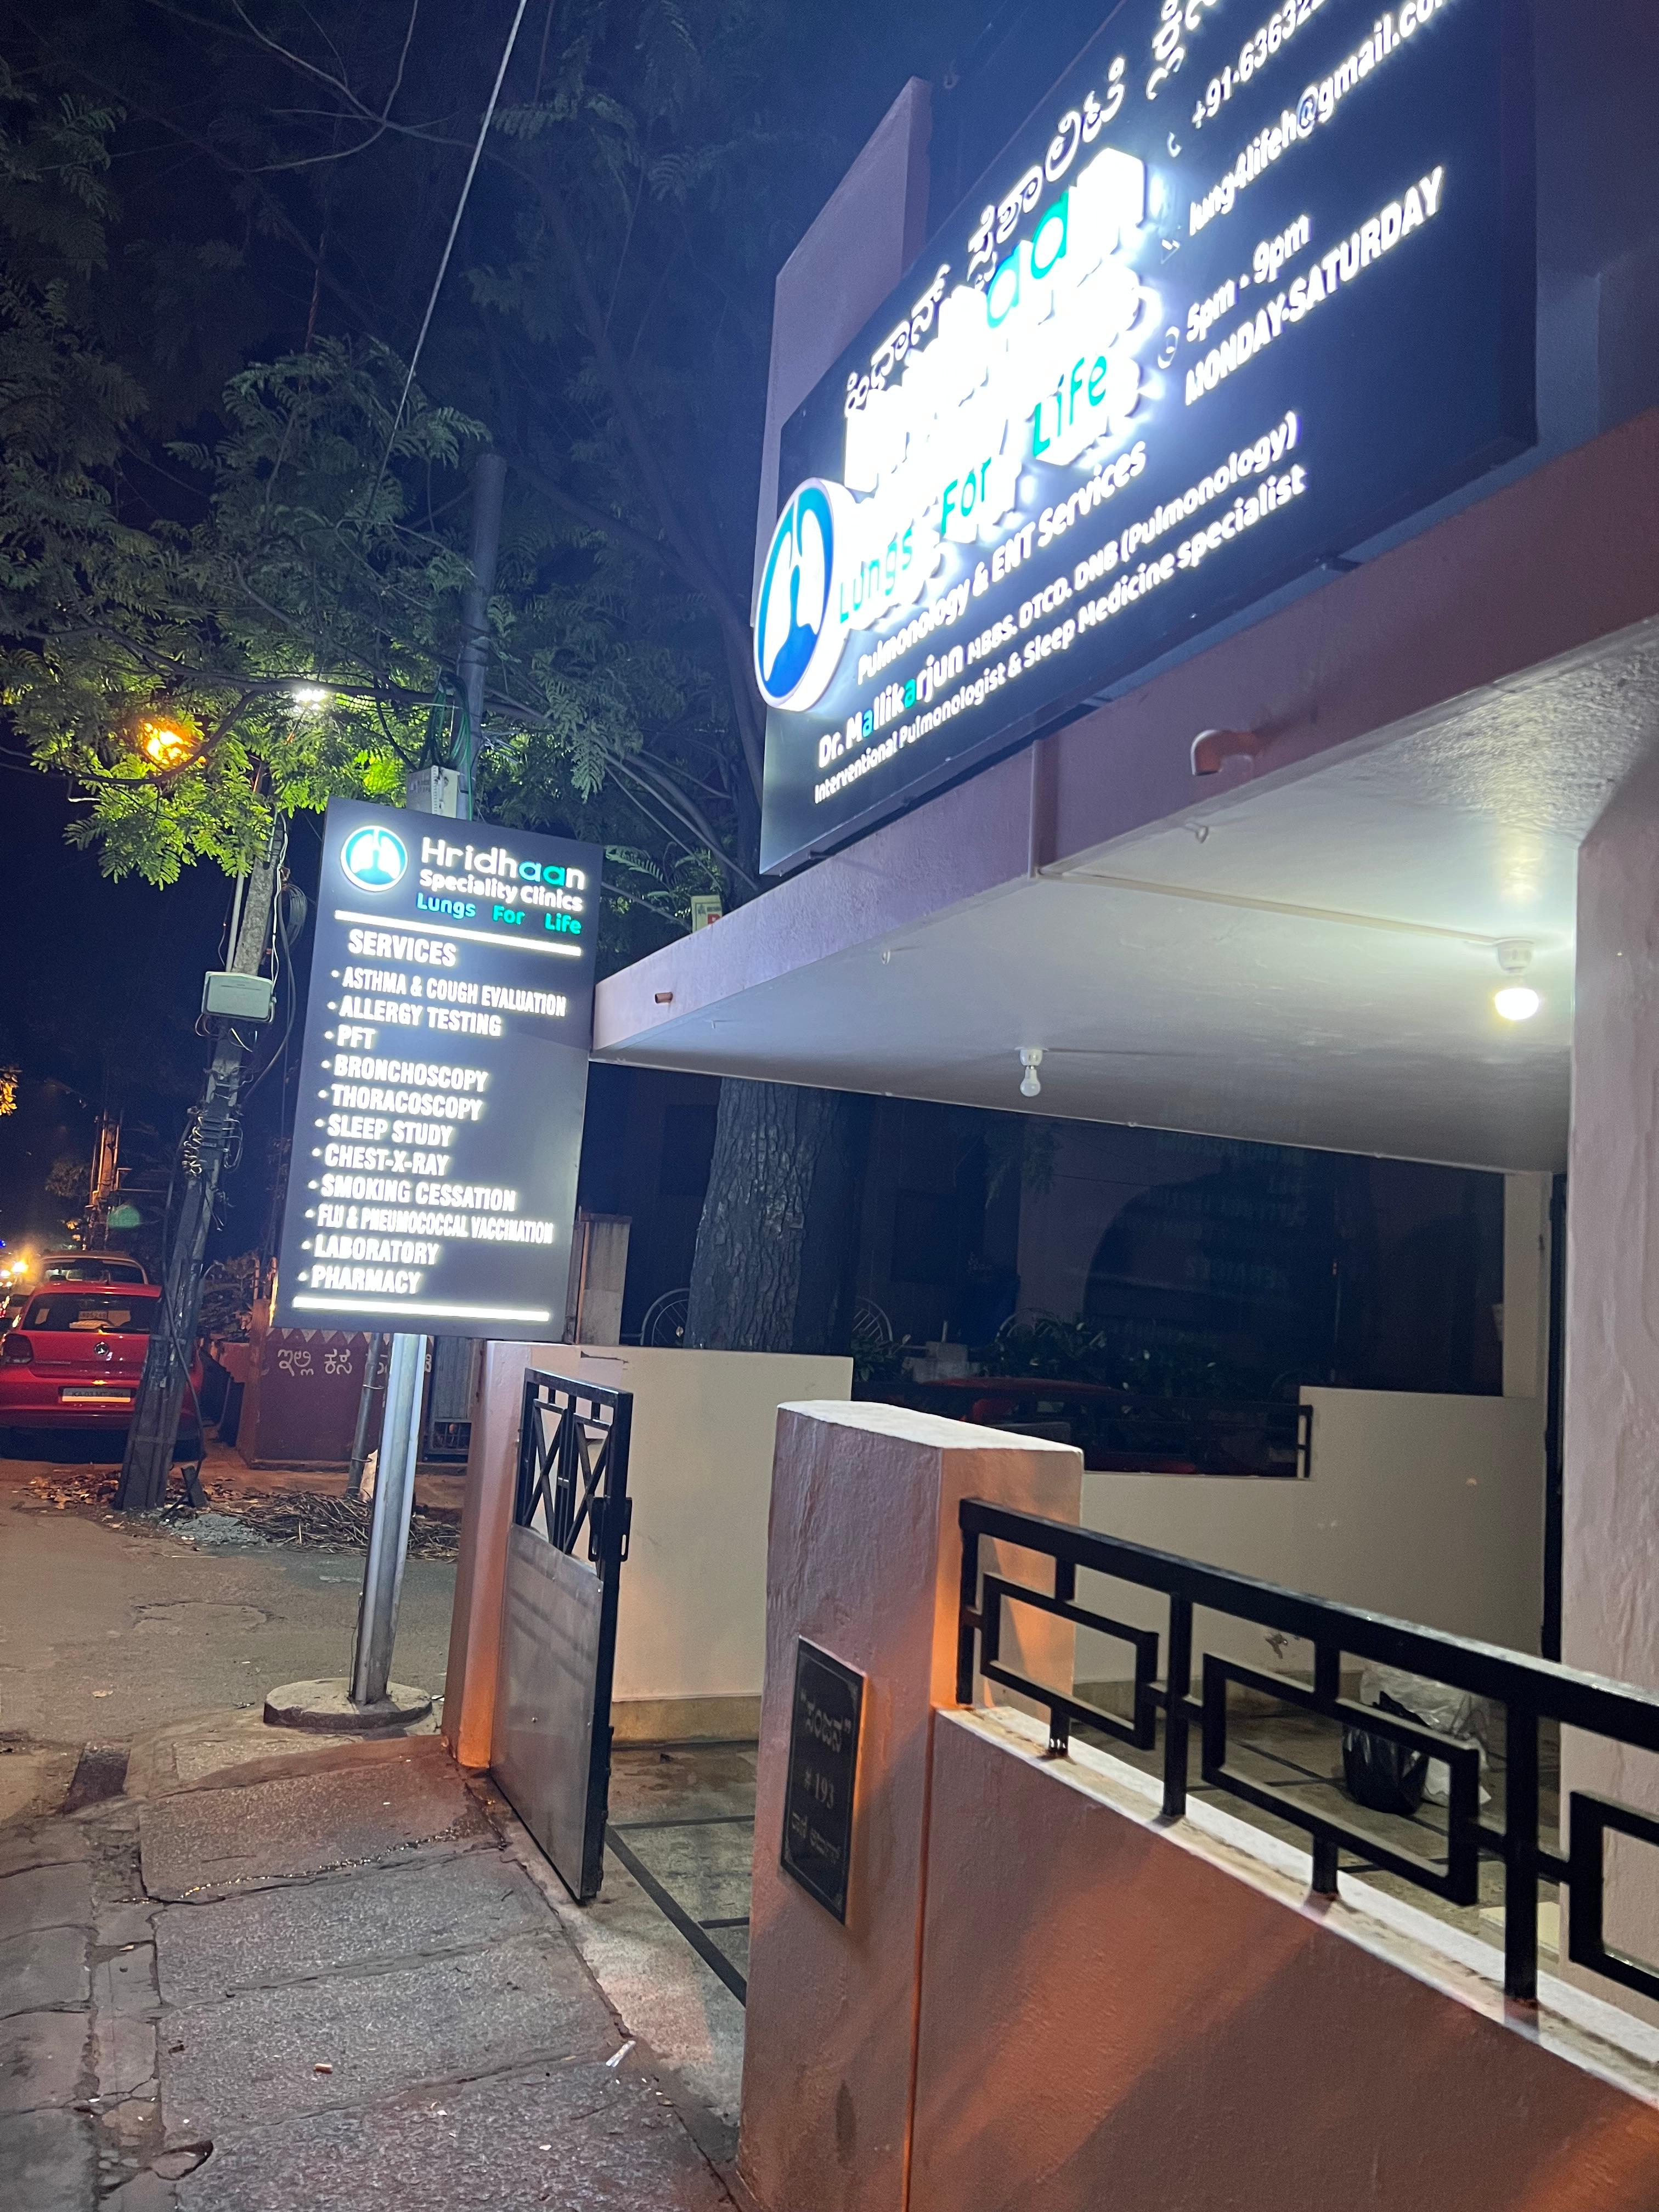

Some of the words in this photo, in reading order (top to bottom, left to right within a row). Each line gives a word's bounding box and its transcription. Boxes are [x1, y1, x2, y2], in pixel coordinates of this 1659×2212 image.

[1186, 279, 1238, 342] 5pm
[1252, 215, 1310, 283] 9pm
[941, 456, 992, 537] For
[1033, 356, 1107, 458] Life
[857, 578, 970, 685] Pulmonology
[973, 561, 988, 597] &
[992, 522, 1036, 583] ENT
[1038, 441, 1146, 547] Services
[819, 731, 844, 768] Dr.
[846, 645, 964, 749] Mallikarjun
[1074, 540, 1118, 591] DNB
[1120, 410, 1299, 562] (Pulmonology)
[815, 731, 899, 804] Interventional
[898, 662, 1006, 749] Pulmonologist
[1007, 652, 1023, 678] &
[1023, 619, 1076, 668] Sleep
[1077, 553, 1175, 633] Medicine
[421, 837, 585, 890] Hridhaan
[420, 868, 518, 904] Speciality
[520, 887, 584, 912] Clinics
[417, 893, 476, 919] Lungs
[492, 905, 525, 926] For
[544, 913, 582, 935] Life
[347, 928, 457, 967] SERVICES
[342, 966, 407, 995] ASTHMA
[410, 975, 422, 997] &
[426, 977, 478, 1005] COUGH
[481, 985, 567, 1017] EVALUATION
[338, 995, 423, 1026] ALLERGY
[427, 1006, 502, 1037] TESTING
[337, 1024, 376, 1049] PFT
[334, 1053, 489, 1092] BRONCHOSCOPY
[330, 1083, 483, 1121] THORACOSCOPY
[327, 1113, 388, 1140] SLEEP
[392, 1120, 453, 1147] STUDY
[324, 1143, 450, 1176] CHEST-X-RAY
[321, 1173, 411, 1204] SMOKING
[415, 1182, 517, 1212] CESSATION
[317, 1204, 344, 1228] FLU
[346, 1205, 358, 1229] &
[360, 1207, 468, 1238] PNEUMOCOCCAL
[471, 1216, 554, 1244] VACCINATION
[314, 1233, 440, 1265] LABORATORY
[310, 1263, 422, 1294] PHARMACY
[277, 1348, 314, 1377] ಇಲ್ಲಿ
[324, 1348, 353, 1375] ಕಸ
